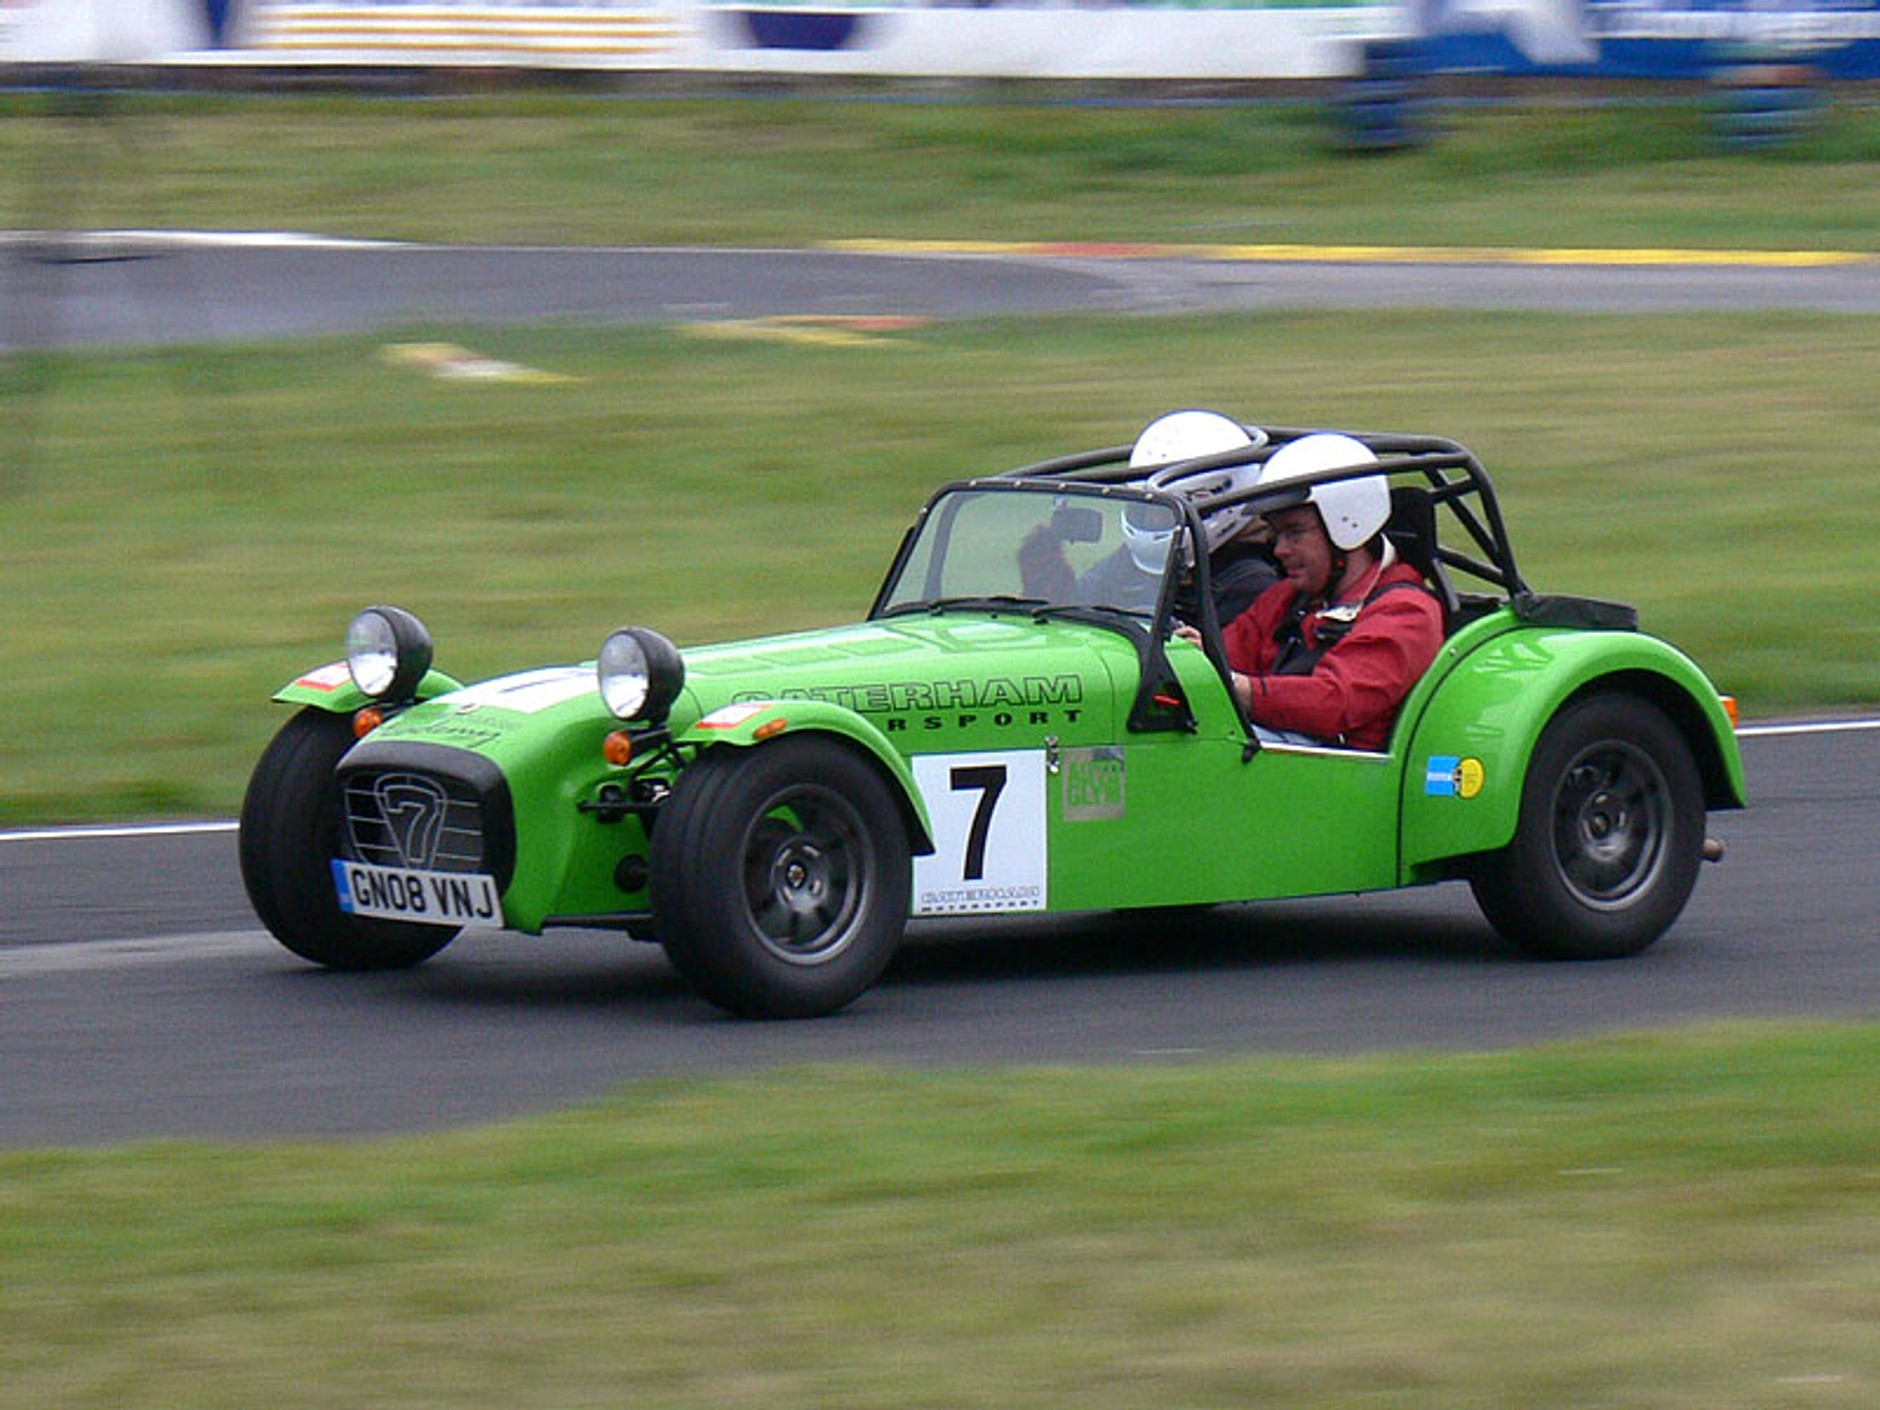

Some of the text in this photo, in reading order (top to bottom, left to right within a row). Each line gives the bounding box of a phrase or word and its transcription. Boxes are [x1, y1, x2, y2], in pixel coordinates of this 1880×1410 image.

[886, 709, 1083, 732] RSPORT
[950, 764, 1008, 880] 7
[429, 877, 495, 919] VNJ
